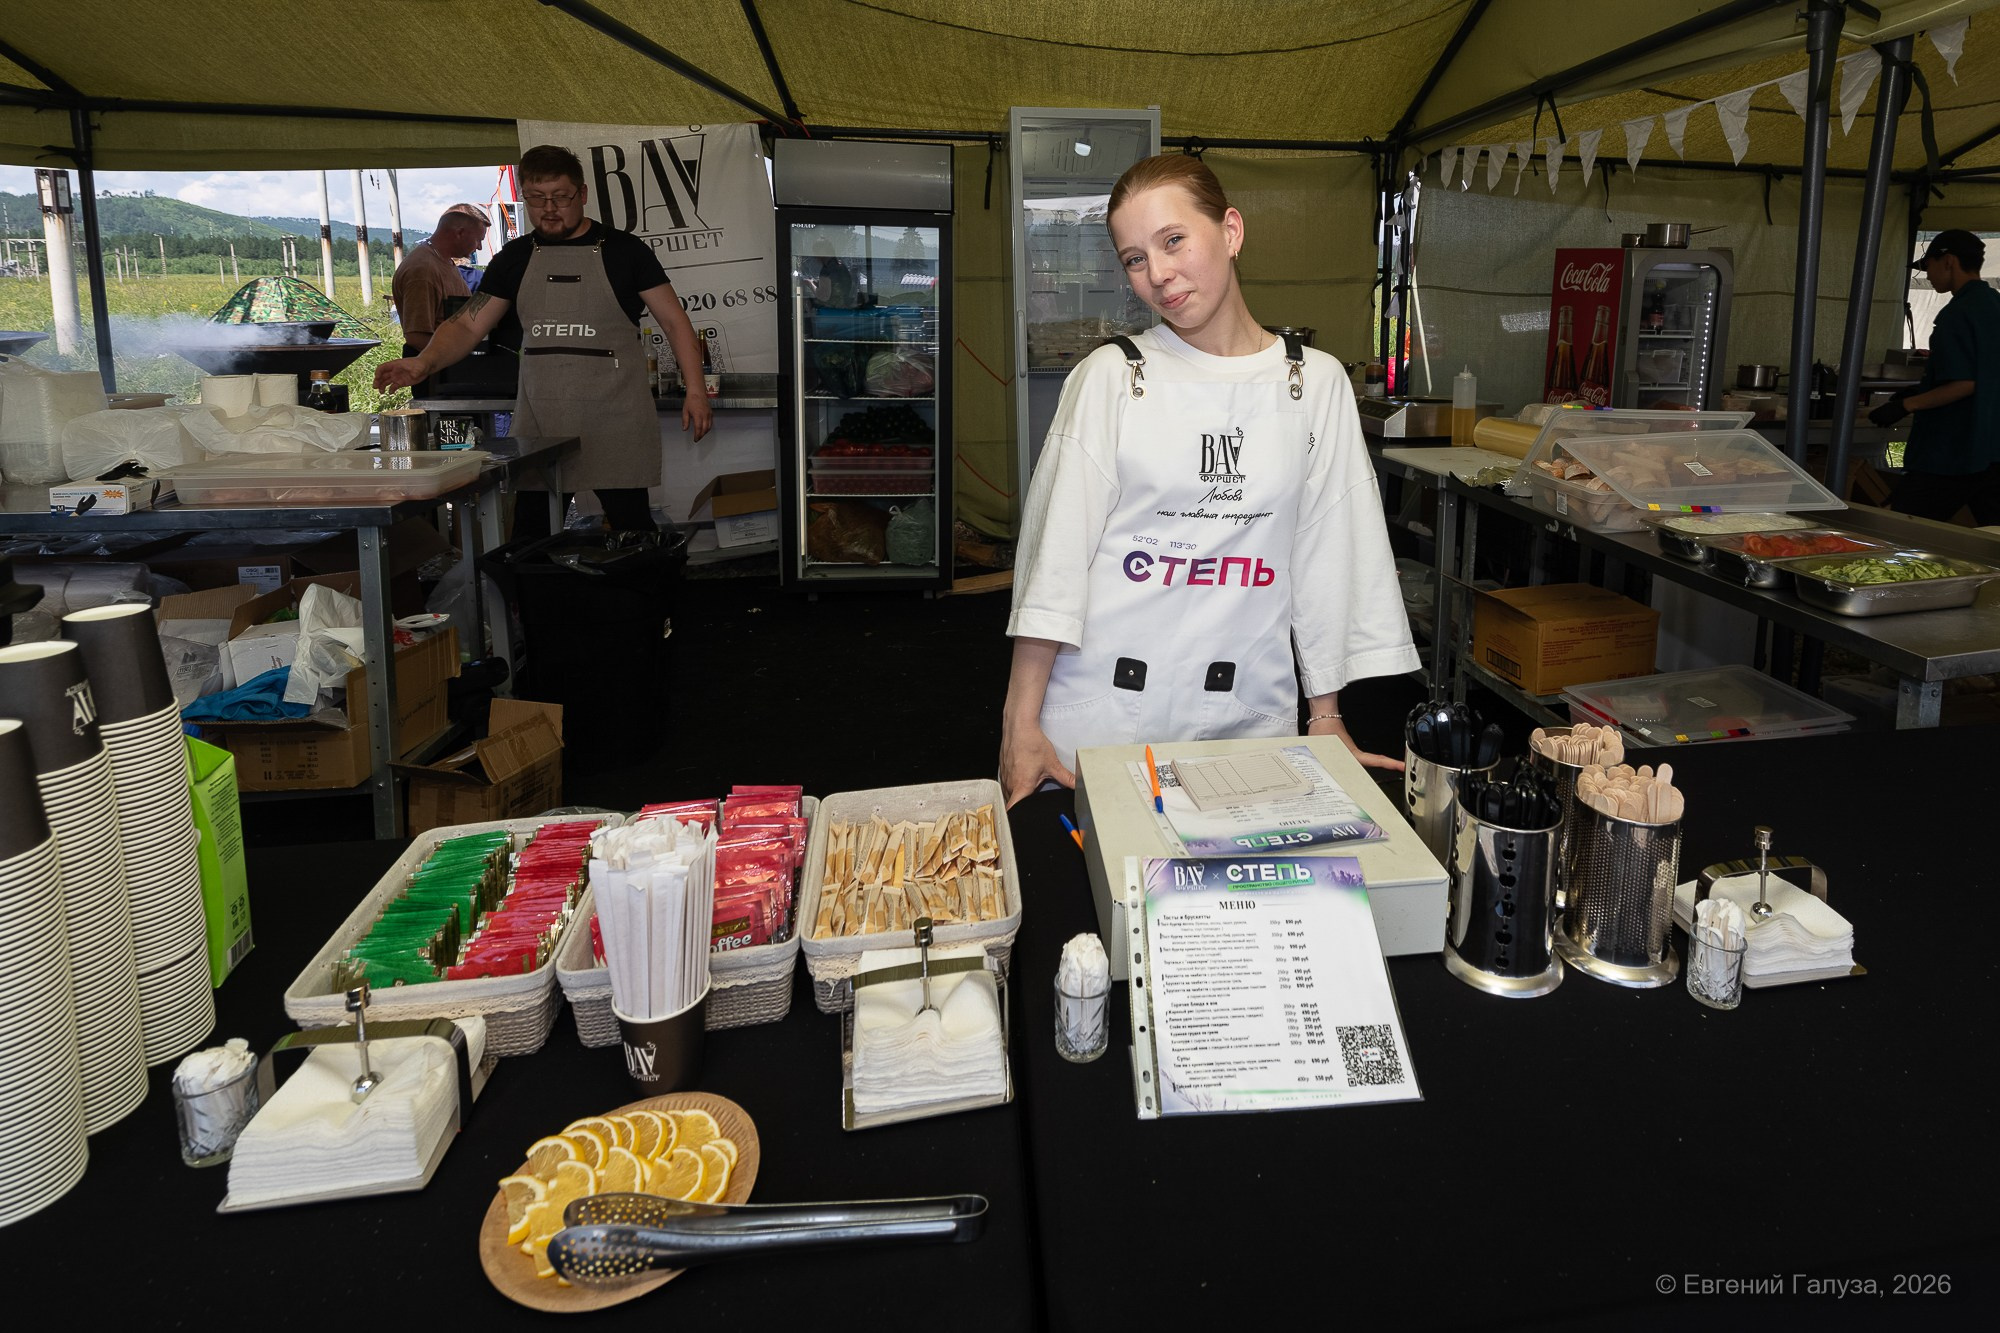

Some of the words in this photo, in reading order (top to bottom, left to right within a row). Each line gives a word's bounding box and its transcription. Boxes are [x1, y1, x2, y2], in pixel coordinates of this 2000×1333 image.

[643, 232, 724, 253] РШЕТ
[1560, 262, 1615, 293] Coca-Cola
[723, 289, 748, 308] 68
[753, 285, 778, 304] 88
[531, 324, 597, 337] СТЕПЬ
[1200, 475, 1247, 484] ФУРШЕТ
[1198, 486, 1243, 504] Любовь
[1156, 510, 1177, 518] наш
[1123, 550, 1275, 588] СТЕПЬ
[1236, 832, 1313, 848] СТЕПЬ
[1226, 863, 1313, 882] СТЕПЬ
[1219, 900, 1256, 910] МЕНЮ
[709, 934, 752, 953] offee
